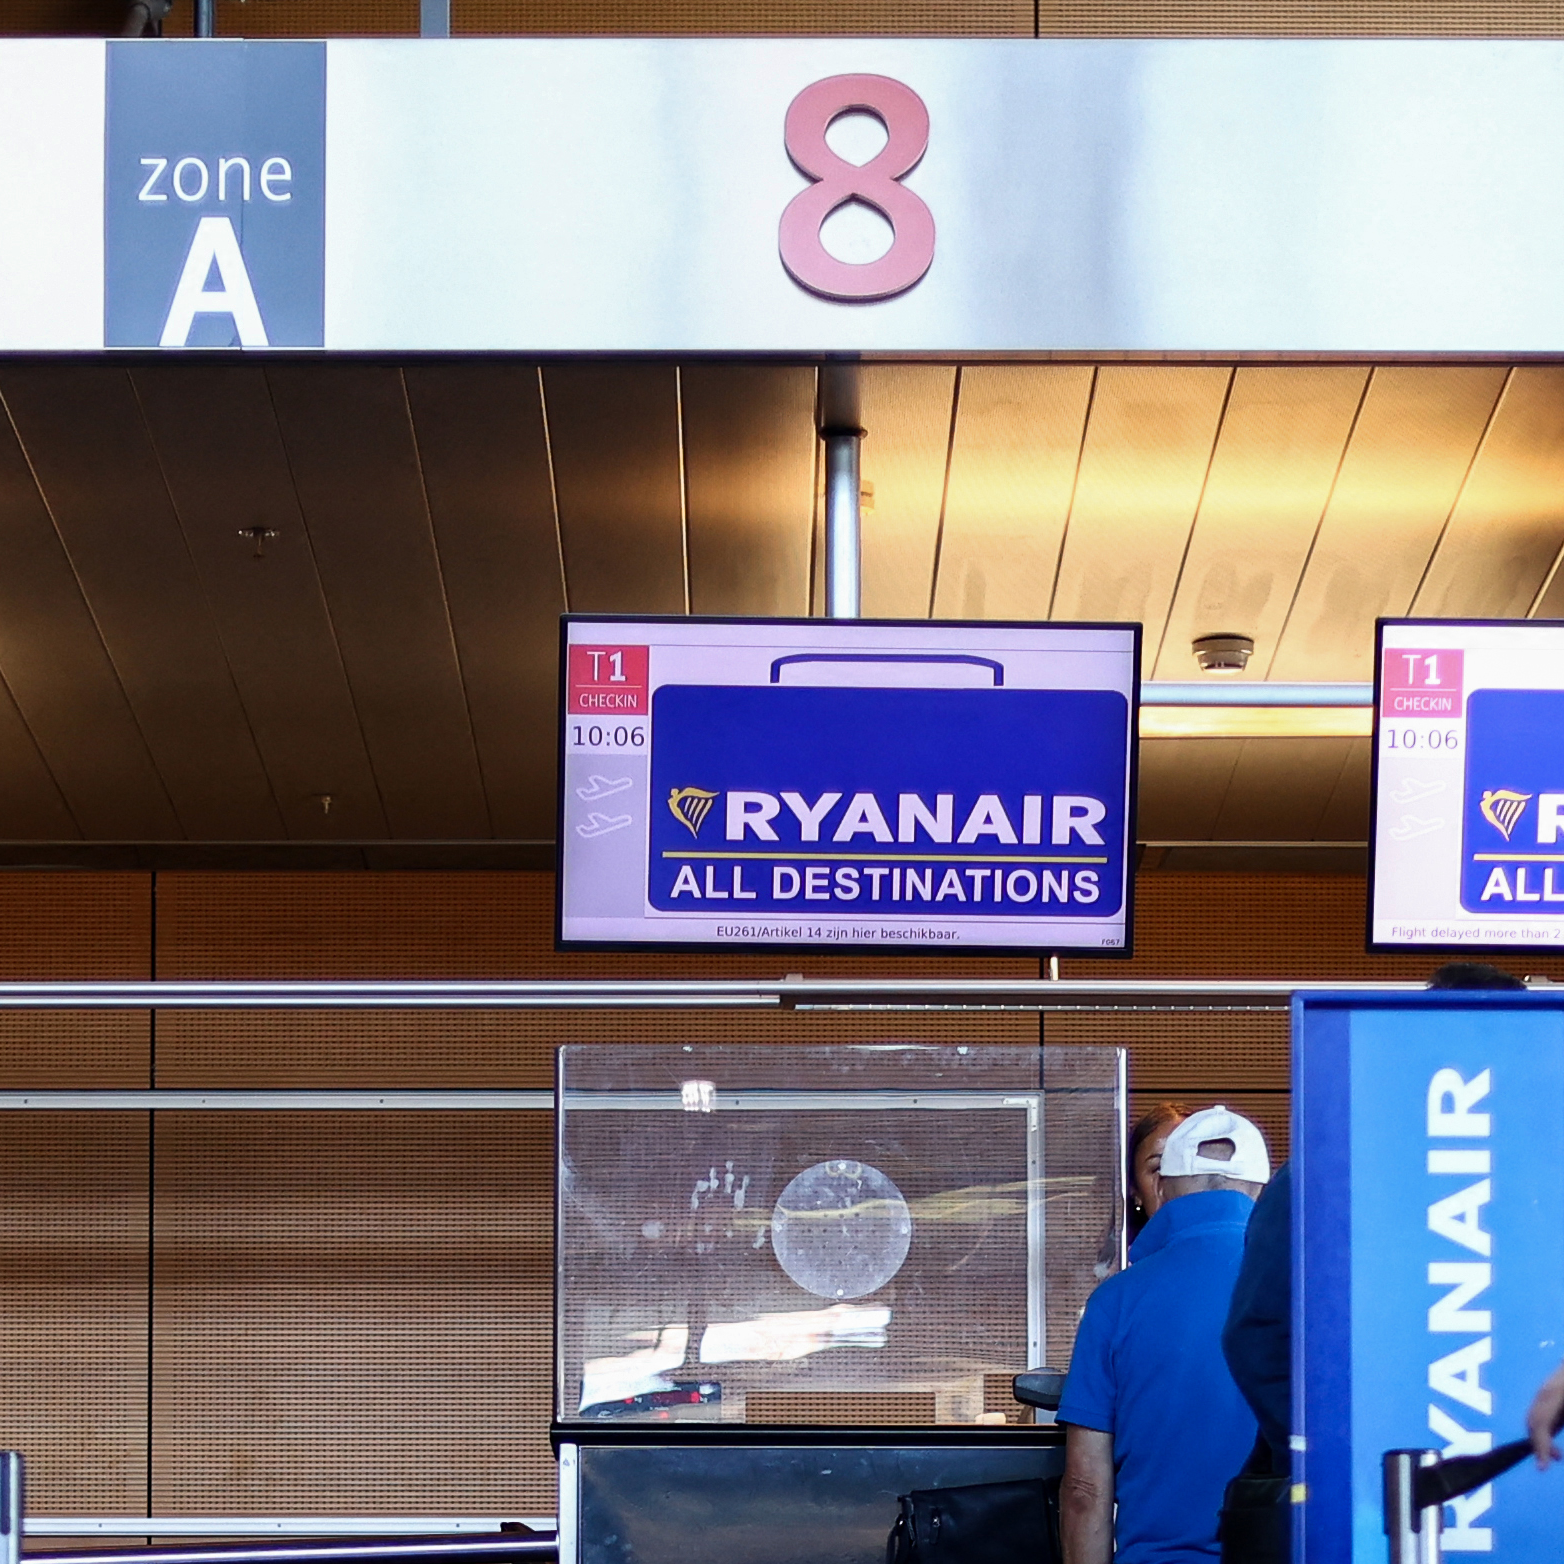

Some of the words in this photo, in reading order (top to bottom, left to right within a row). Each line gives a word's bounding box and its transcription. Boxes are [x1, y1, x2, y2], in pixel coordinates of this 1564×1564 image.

[138, 155, 293, 202] zone
[778, 73, 935, 304] 8
[160, 216, 269, 347] A
[587, 651, 626, 682] T1
[1402, 654, 1441, 685] T1
[579, 694, 638, 709] CHECKIN
[1393, 696, 1452, 712] CHECKIN
[572, 725, 645, 747] 10:06
[1387, 729, 1459, 750] 10:06
[725, 791, 1107, 845] RYANAIR
[670, 866, 756, 899] ALL
[772, 867, 1100, 903] DESTINATIONS
[716, 926, 802, 938] EU261/Artikel
[807, 926, 822, 938] 14
[826, 927, 848, 940] zijn
[852, 927, 876, 939] hier
[880, 928, 961, 940] beschikbaar.
[1392, 926, 1426, 940] Flight
[1431, 927, 1480, 940] delayed
[1484, 930, 1517, 938] more
[1521, 928, 1549, 939] than
[1554, 928, 1561, 939] 2
